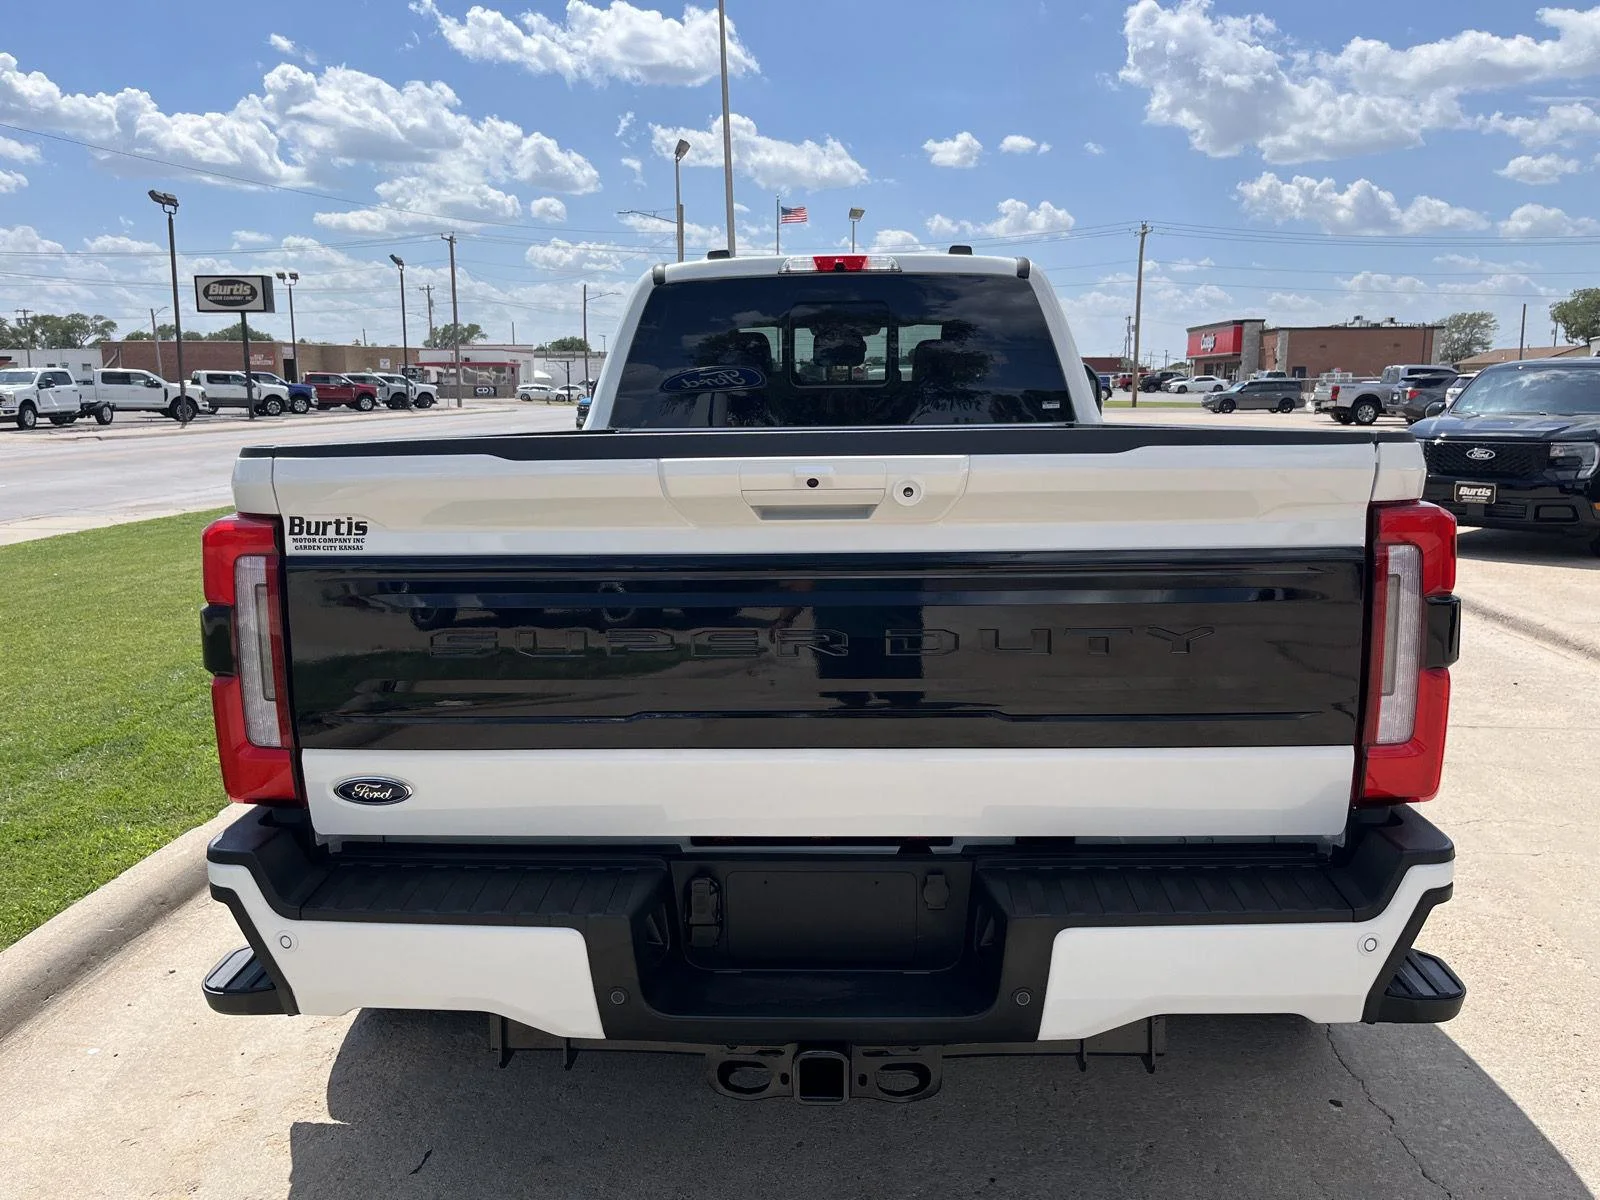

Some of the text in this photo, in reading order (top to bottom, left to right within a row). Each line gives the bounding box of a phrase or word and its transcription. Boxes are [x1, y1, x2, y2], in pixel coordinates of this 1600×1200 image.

[208, 283, 251, 295] Burtis
[1458, 486, 1492, 497] Burtis
[288, 516, 368, 536] Burtis
[430, 626, 1216, 658] SUPER DUTY
[351, 783, 393, 799] Ford
